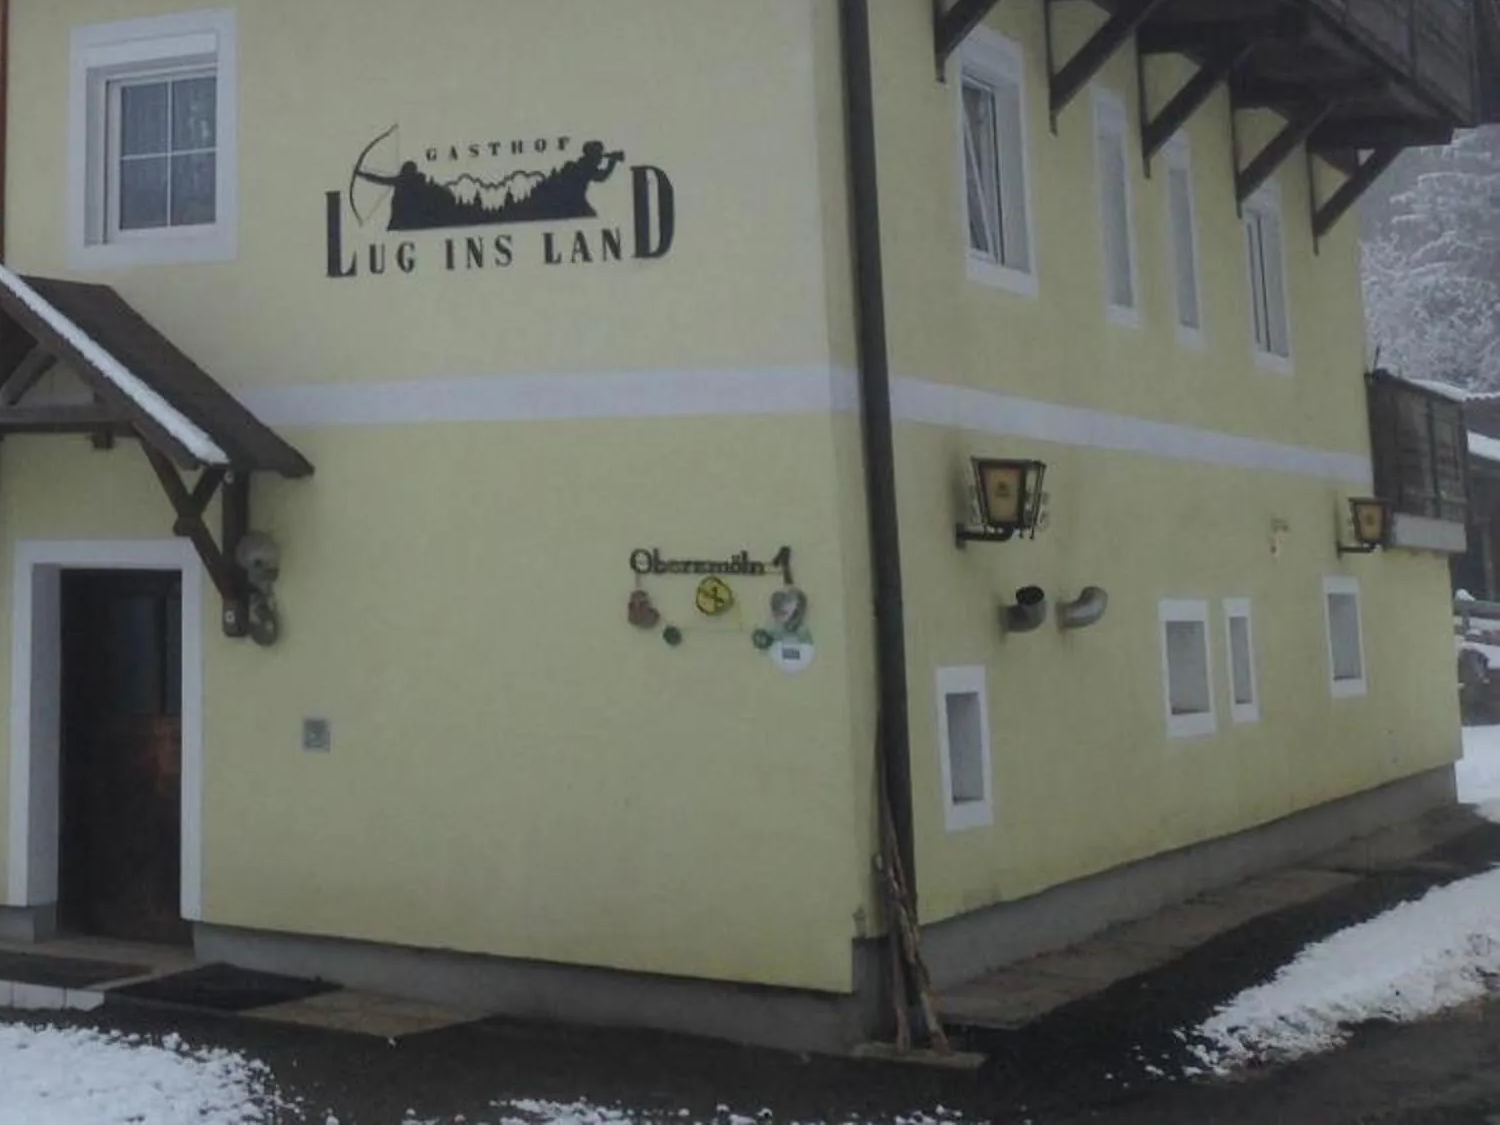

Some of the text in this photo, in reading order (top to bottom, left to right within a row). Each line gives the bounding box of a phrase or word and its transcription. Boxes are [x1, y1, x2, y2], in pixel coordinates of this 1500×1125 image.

[425, 135, 572, 162] GASTHOF
[325, 164, 675, 278] LUG INS LAND
